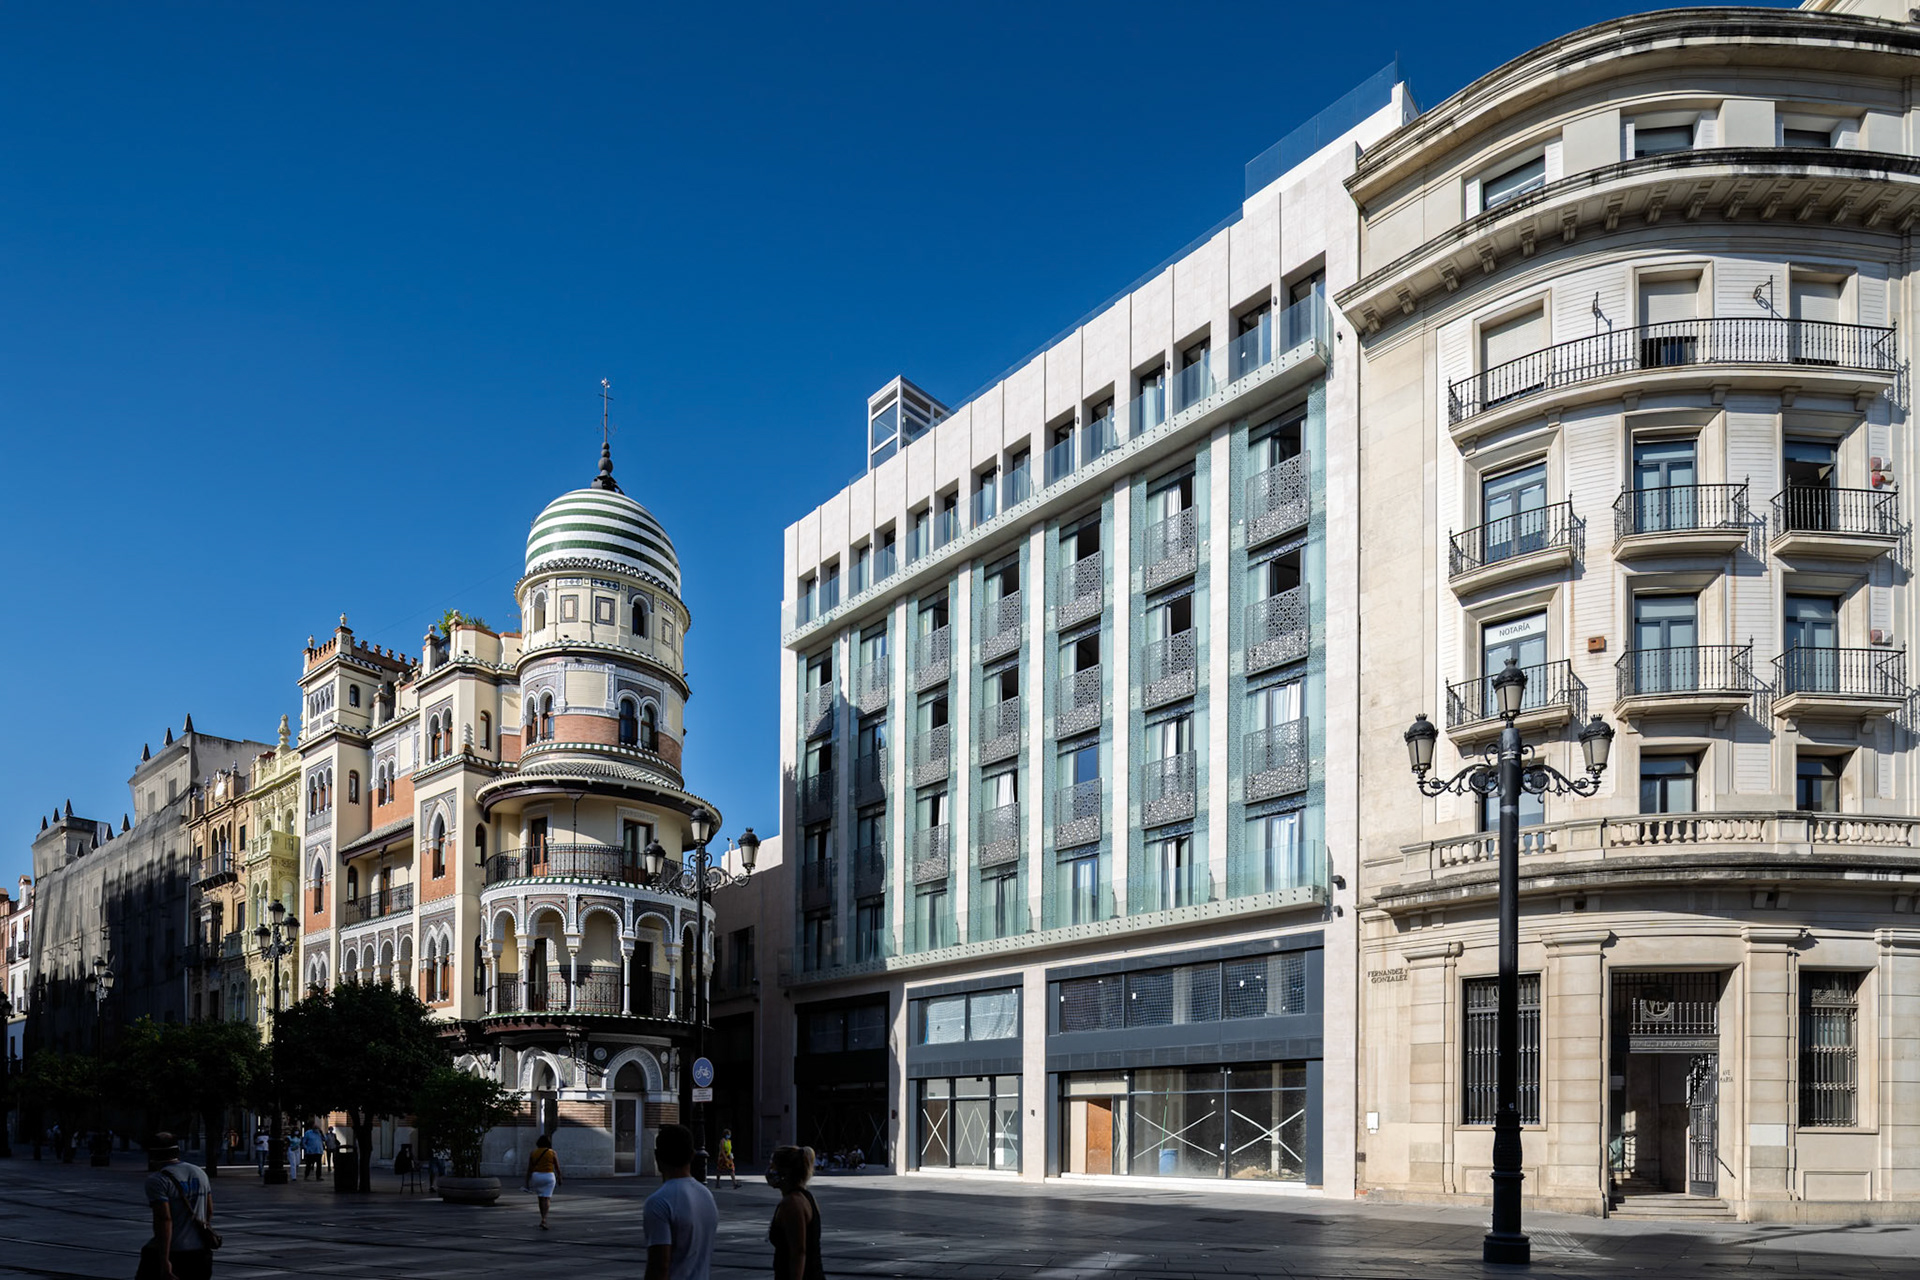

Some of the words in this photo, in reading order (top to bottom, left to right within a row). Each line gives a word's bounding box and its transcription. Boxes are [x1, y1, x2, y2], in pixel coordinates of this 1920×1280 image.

[1499, 622, 1531, 637] NOTARÍA
[1367, 968, 1403, 977] FERNANDEZ
[1371, 975, 1408, 984] GONZALEZ
